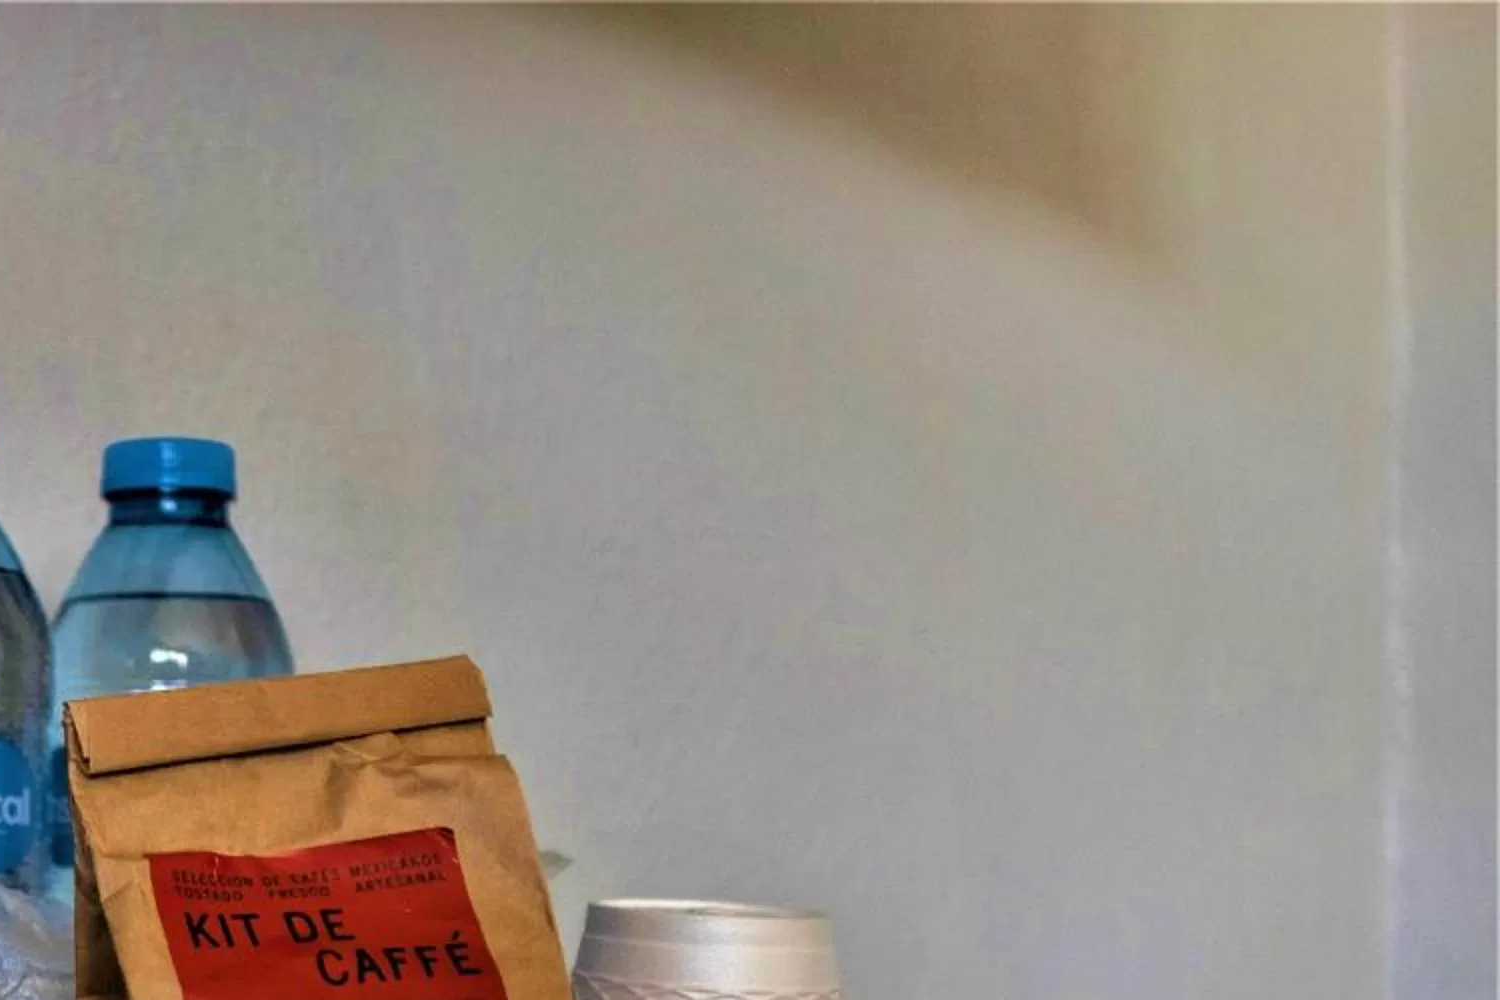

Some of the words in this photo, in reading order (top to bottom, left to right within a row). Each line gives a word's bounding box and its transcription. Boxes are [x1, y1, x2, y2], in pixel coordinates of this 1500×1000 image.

[174, 885, 244, 901] TOSTADO
[268, 885, 330, 898] FRESCO
[356, 870, 447, 892] ARTESANAL
[184, 911, 260, 949] KIT
[283, 907, 355, 944] DE
[315, 930, 484, 987] CAFFÉ
